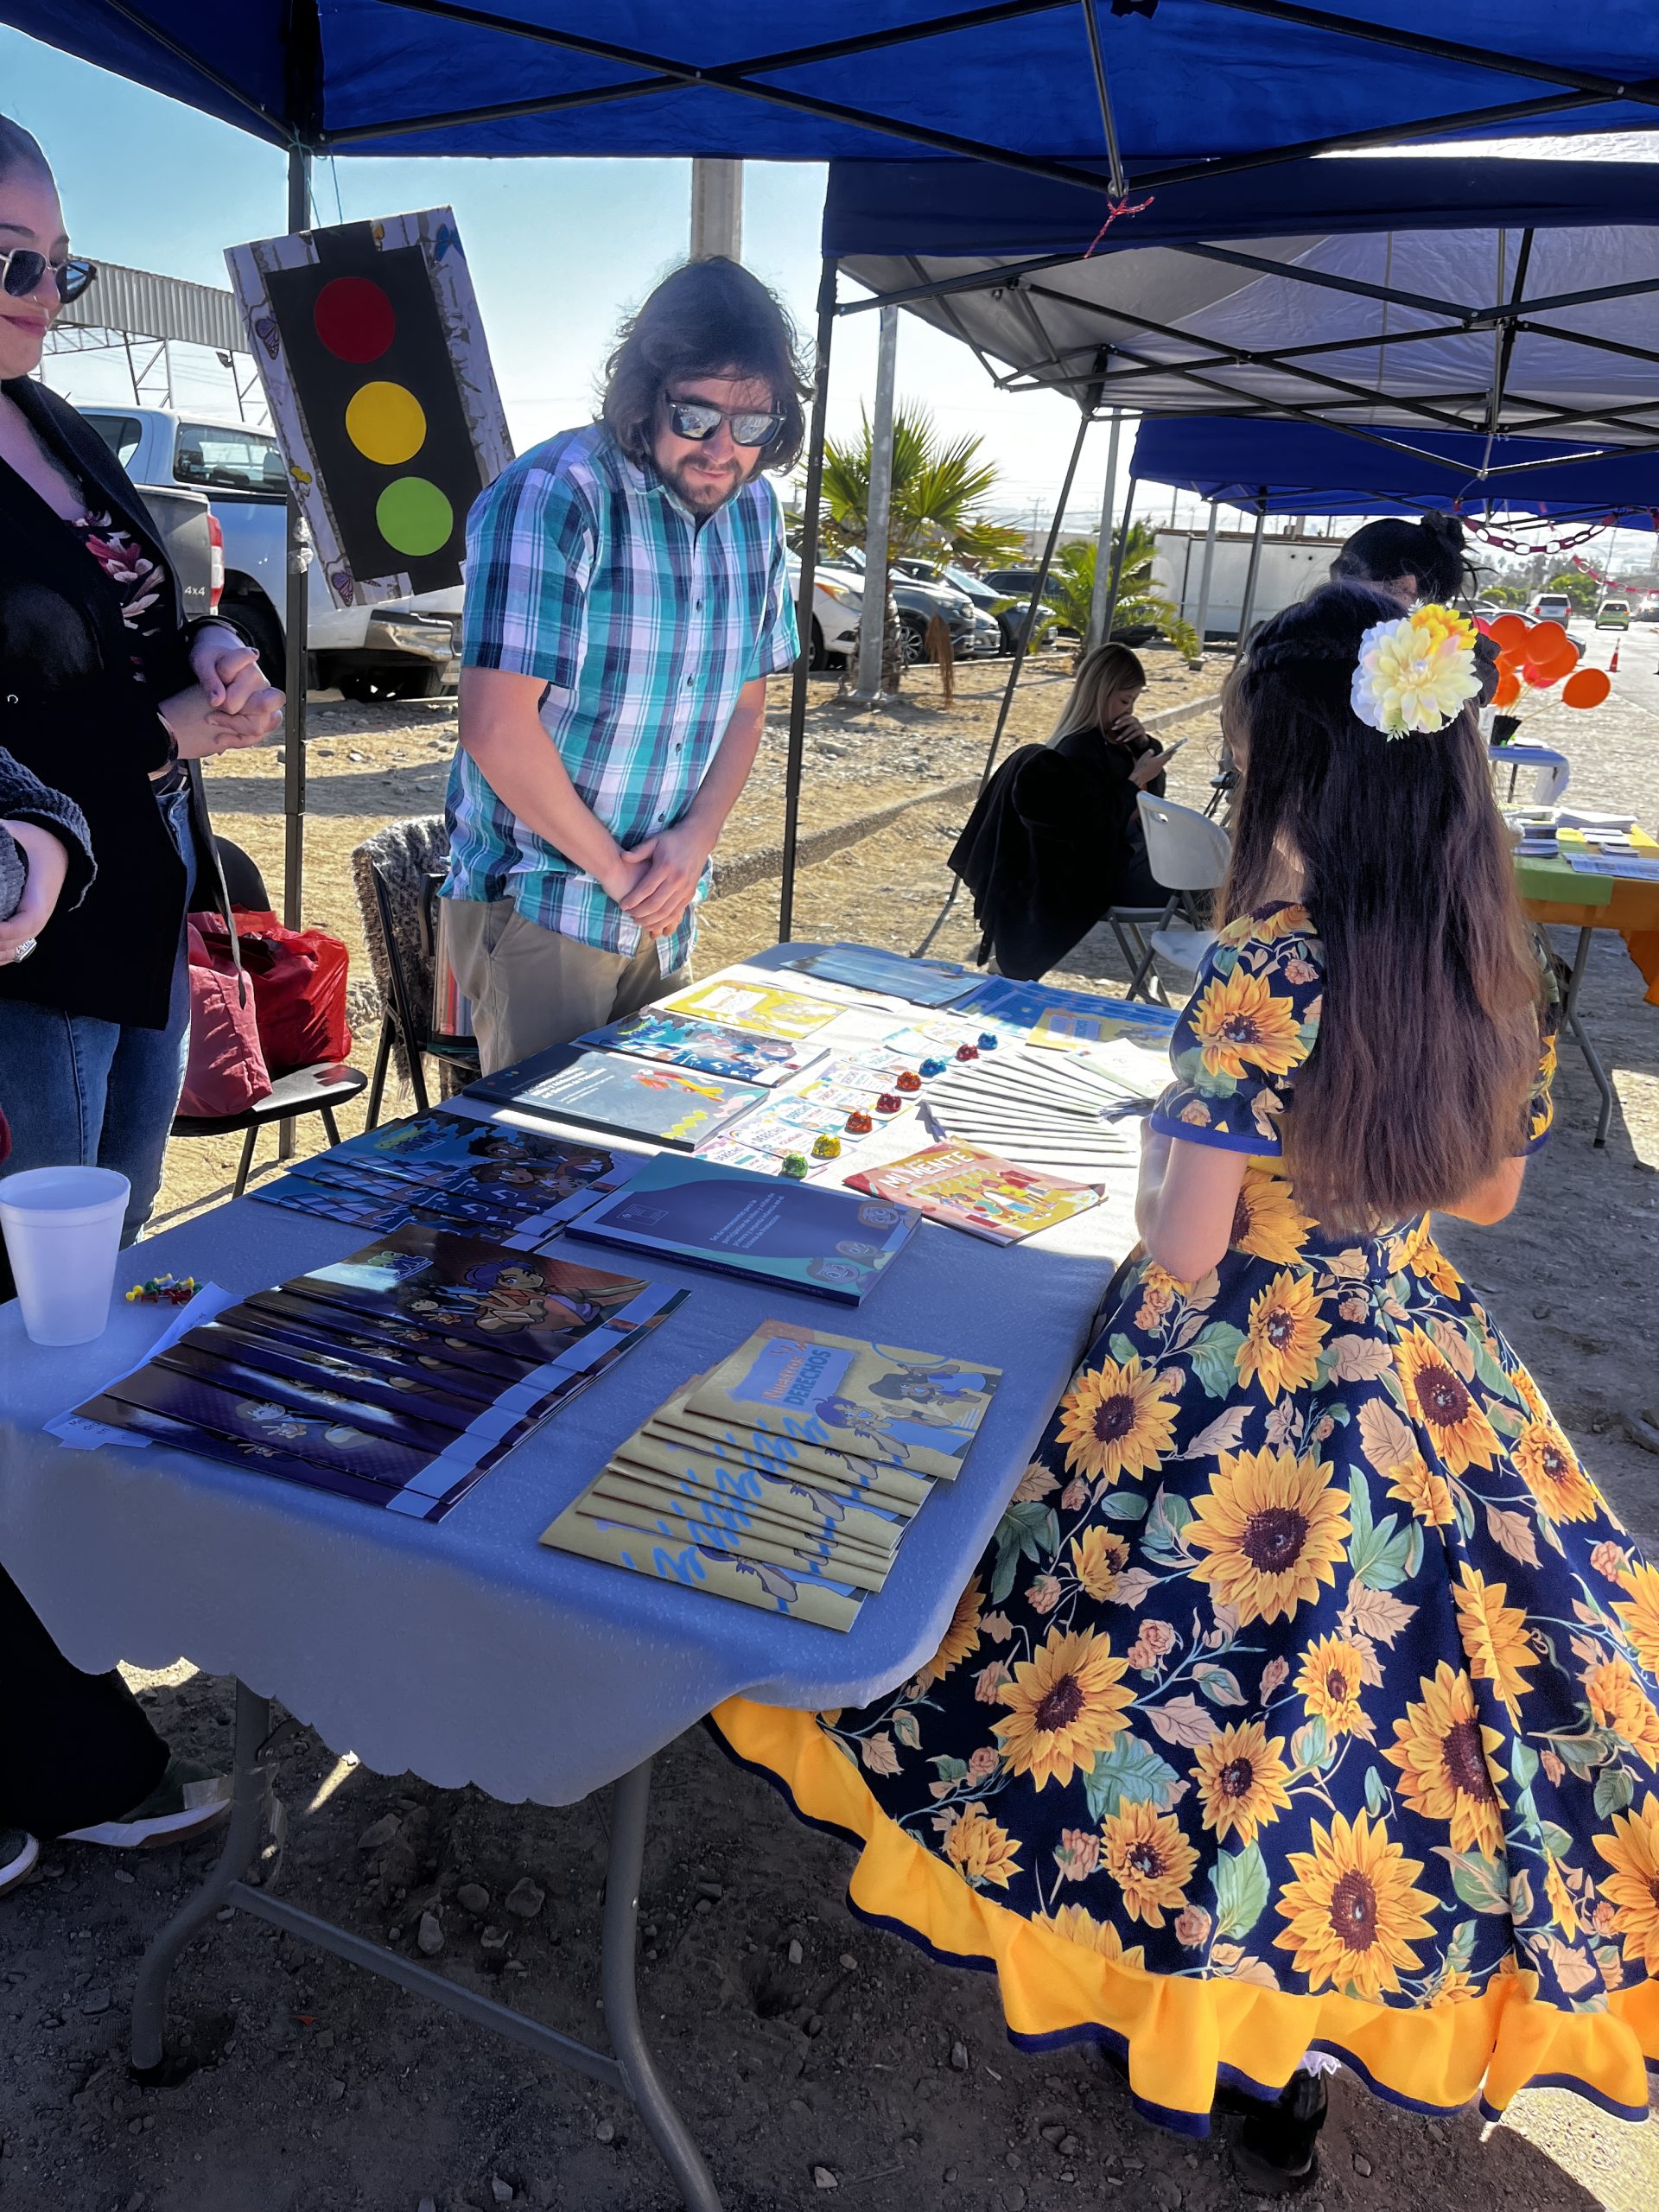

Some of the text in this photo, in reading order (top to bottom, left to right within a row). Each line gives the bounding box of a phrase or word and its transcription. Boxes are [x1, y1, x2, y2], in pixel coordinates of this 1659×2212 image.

[878, 1173, 913, 1189] MI
[901, 1151, 976, 1179] MENTE
[760, 1355, 806, 1402] Nuestros
[783, 1349, 832, 1407] DERECHOS
